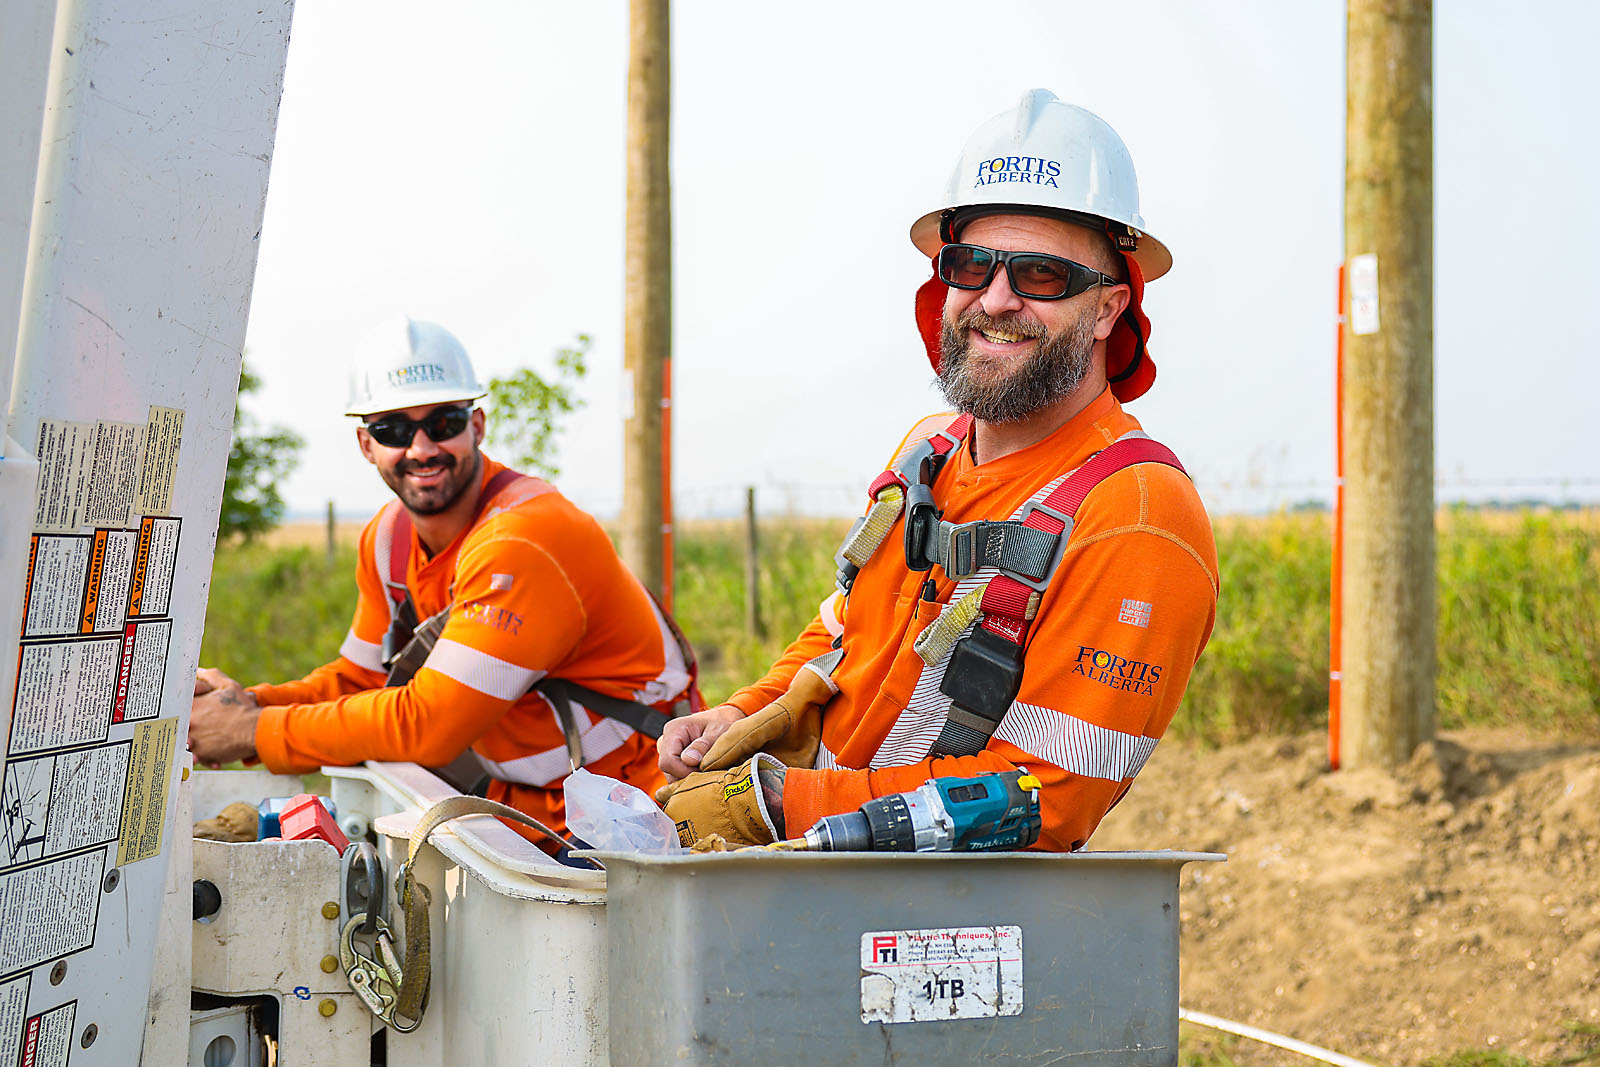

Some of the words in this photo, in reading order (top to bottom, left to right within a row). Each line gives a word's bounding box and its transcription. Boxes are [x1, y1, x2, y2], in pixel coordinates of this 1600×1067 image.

[974, 172, 1059, 189] ALBERTA
[976, 156, 1061, 177] FORTIS
[89, 539, 103, 603] WARNING
[135, 524, 150, 592] WARNING
[119, 636, 133, 696] DANGER
[1071, 663, 1153, 696] ALBERTA
[1074, 645, 1162, 684] FORTIS
[941, 931, 993, 941] Tehniques,
[922, 979, 965, 1000] 1TB
